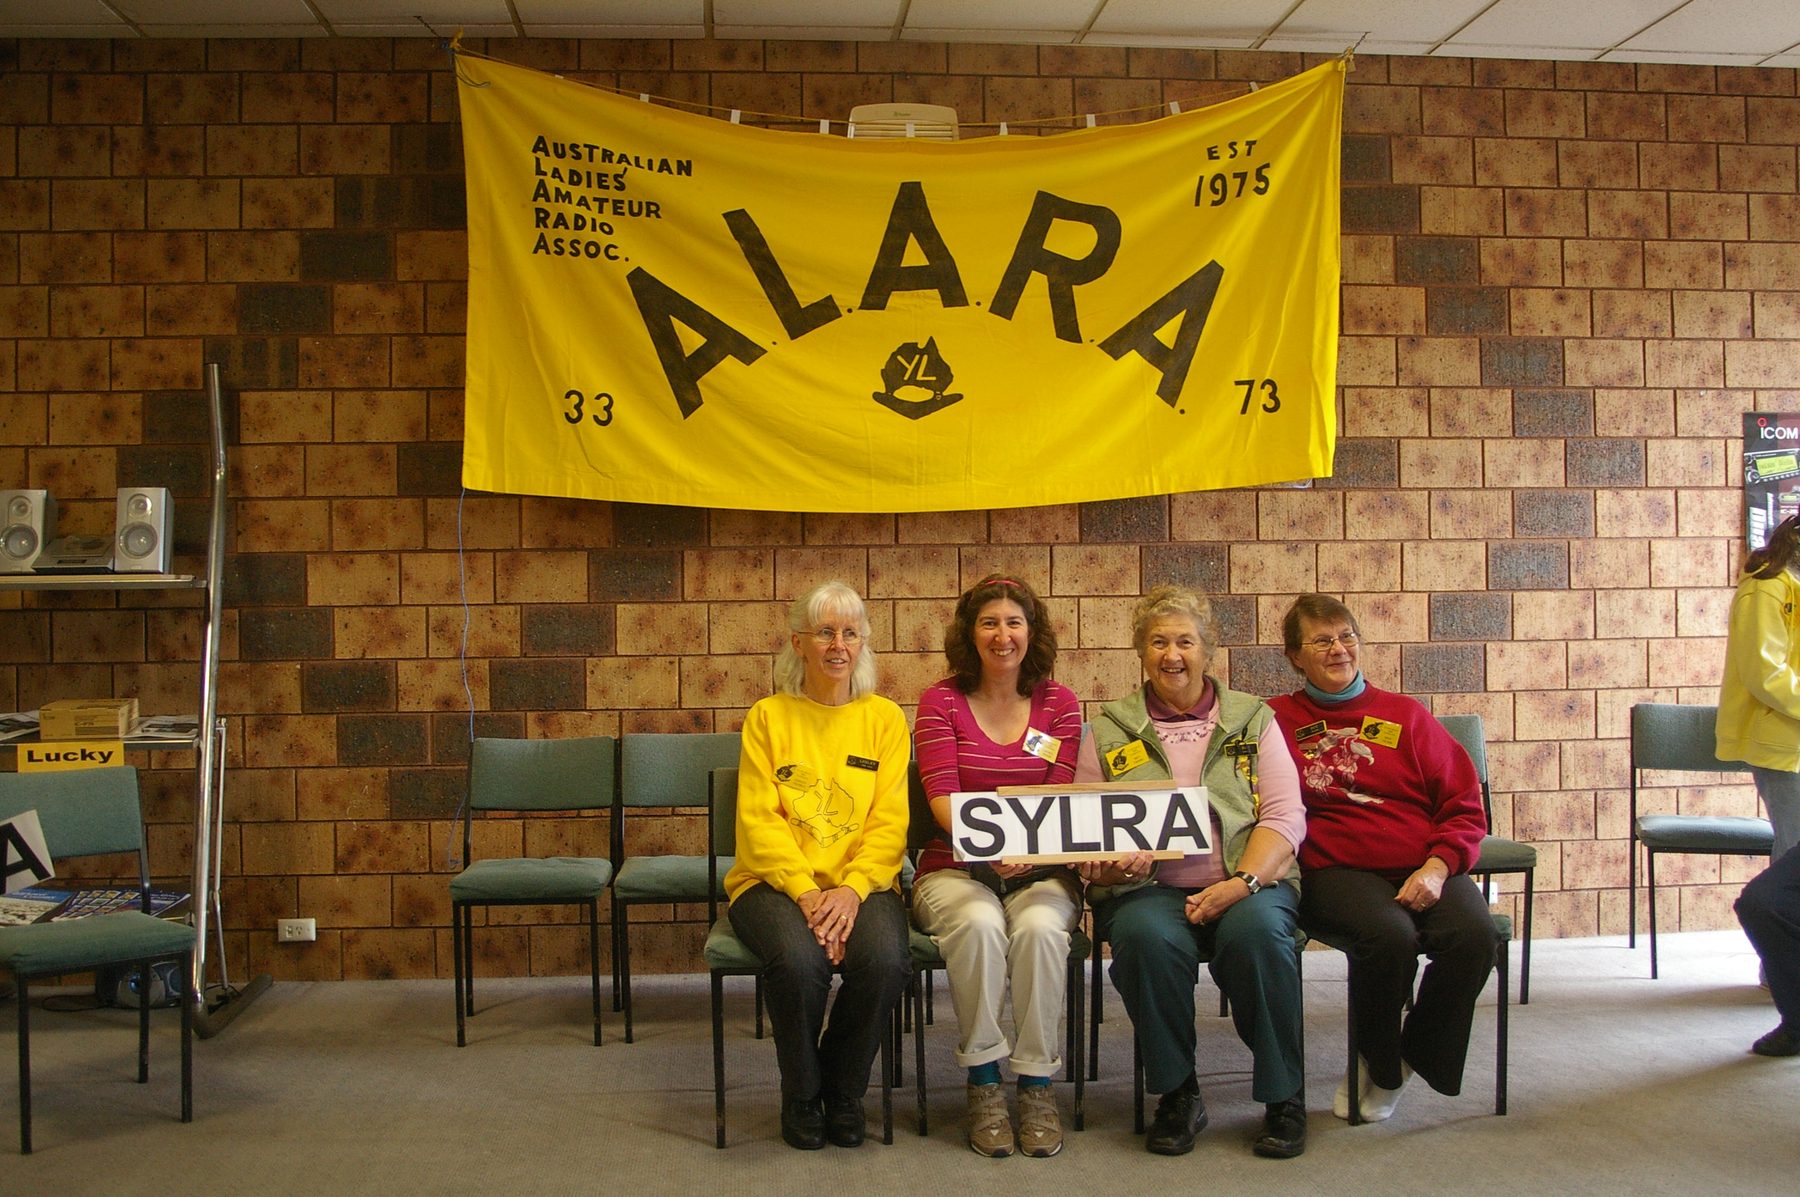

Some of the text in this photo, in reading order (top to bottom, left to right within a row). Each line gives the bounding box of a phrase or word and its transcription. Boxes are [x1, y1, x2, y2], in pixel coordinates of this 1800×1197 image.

[531, 134, 693, 177] AUSTRALIAN
[1206, 139, 1258, 161] EST
[531, 178, 662, 219] AMATEUR
[1194, 162, 1271, 207] 1975
[534, 206, 614, 236] RADIO
[532, 232, 630, 263] ASSOC.
[897, 354, 937, 381] YL
[563, 389, 614, 427] 33
[1234, 379, 1282, 415] 73
[1760, 427, 1798, 440] ICOM
[26, 748, 114, 764] Lucky
[959, 793, 1210, 858] SYLRA
